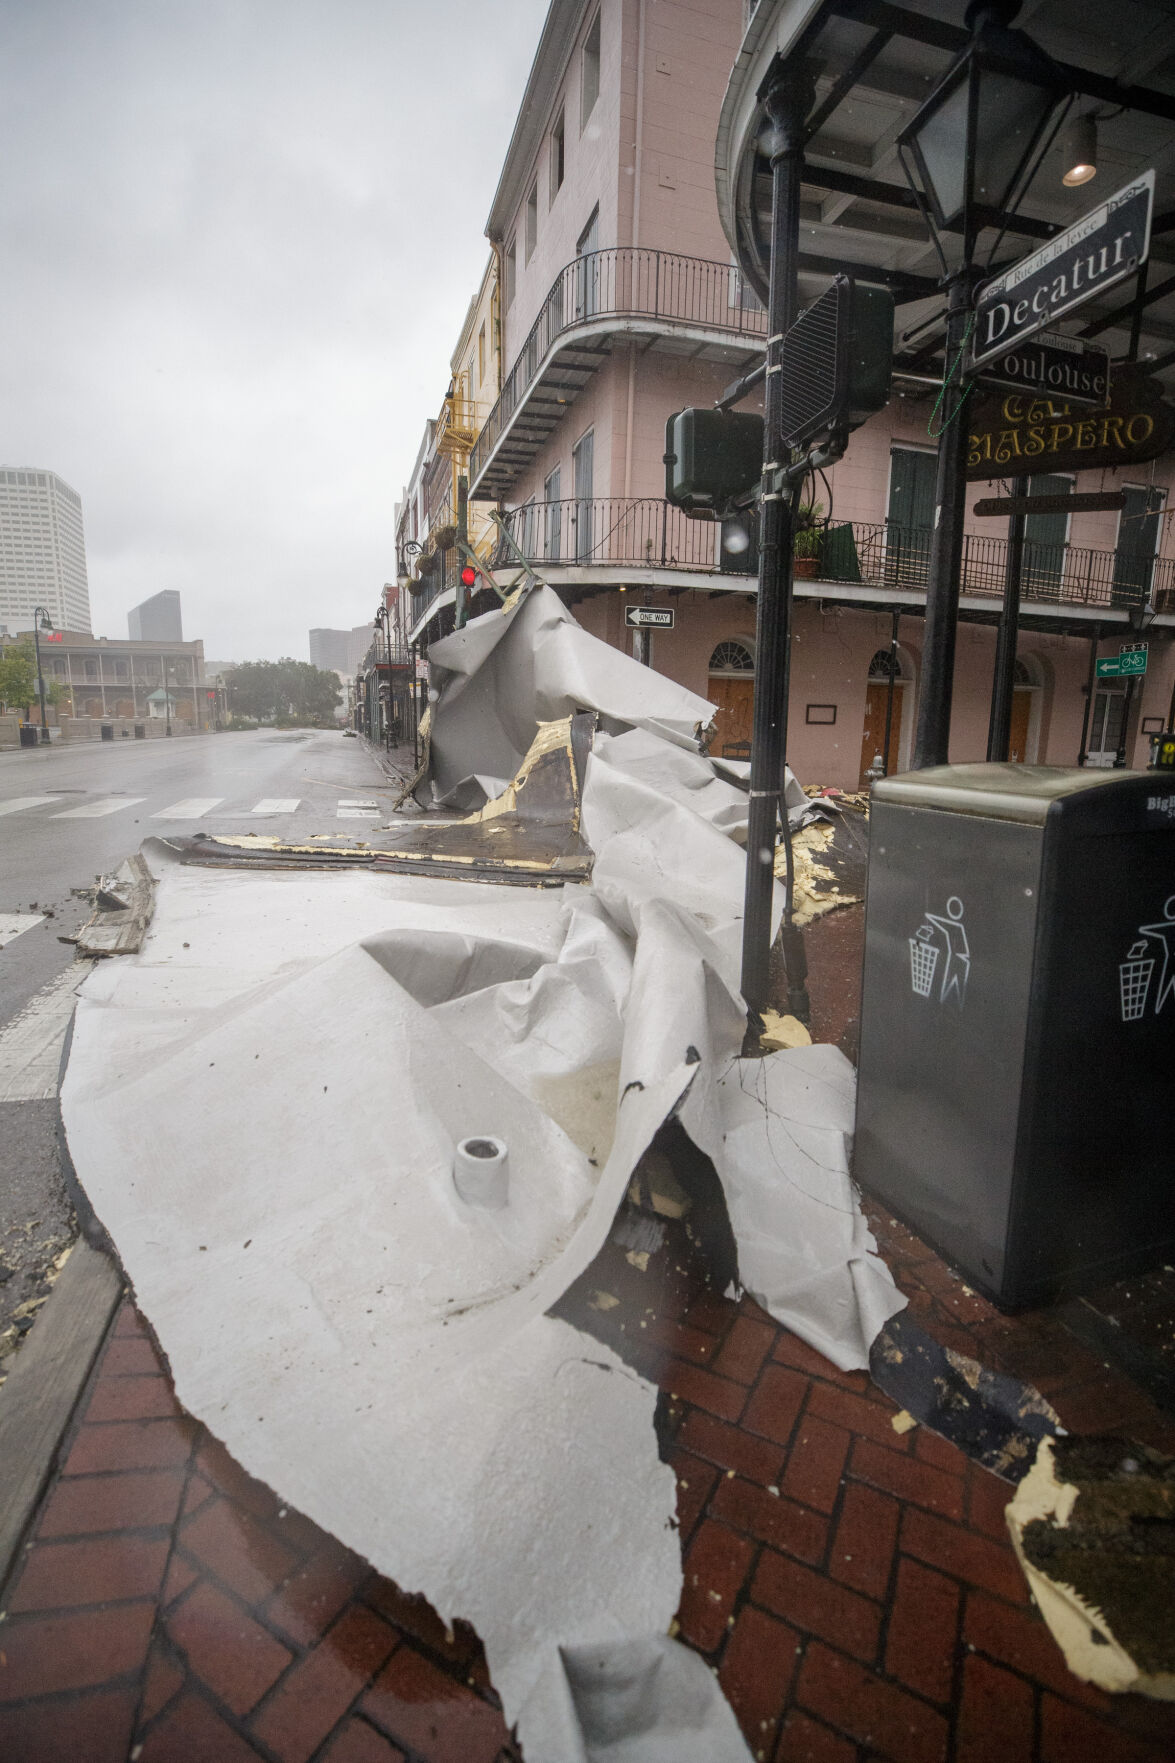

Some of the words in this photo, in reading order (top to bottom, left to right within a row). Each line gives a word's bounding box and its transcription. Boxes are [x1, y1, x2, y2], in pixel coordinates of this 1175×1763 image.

[1013, 263, 1034, 284] Rue
[1036, 253, 1049, 268] de
[1053, 244, 1063, 256] la
[984, 231, 1132, 345] Decatur
[986, 351, 1105, 394] oulouse
[967, 414, 1154, 466] MASPERO
[640, 613, 653, 621] ONE
[655, 614, 669, 622] WAY
